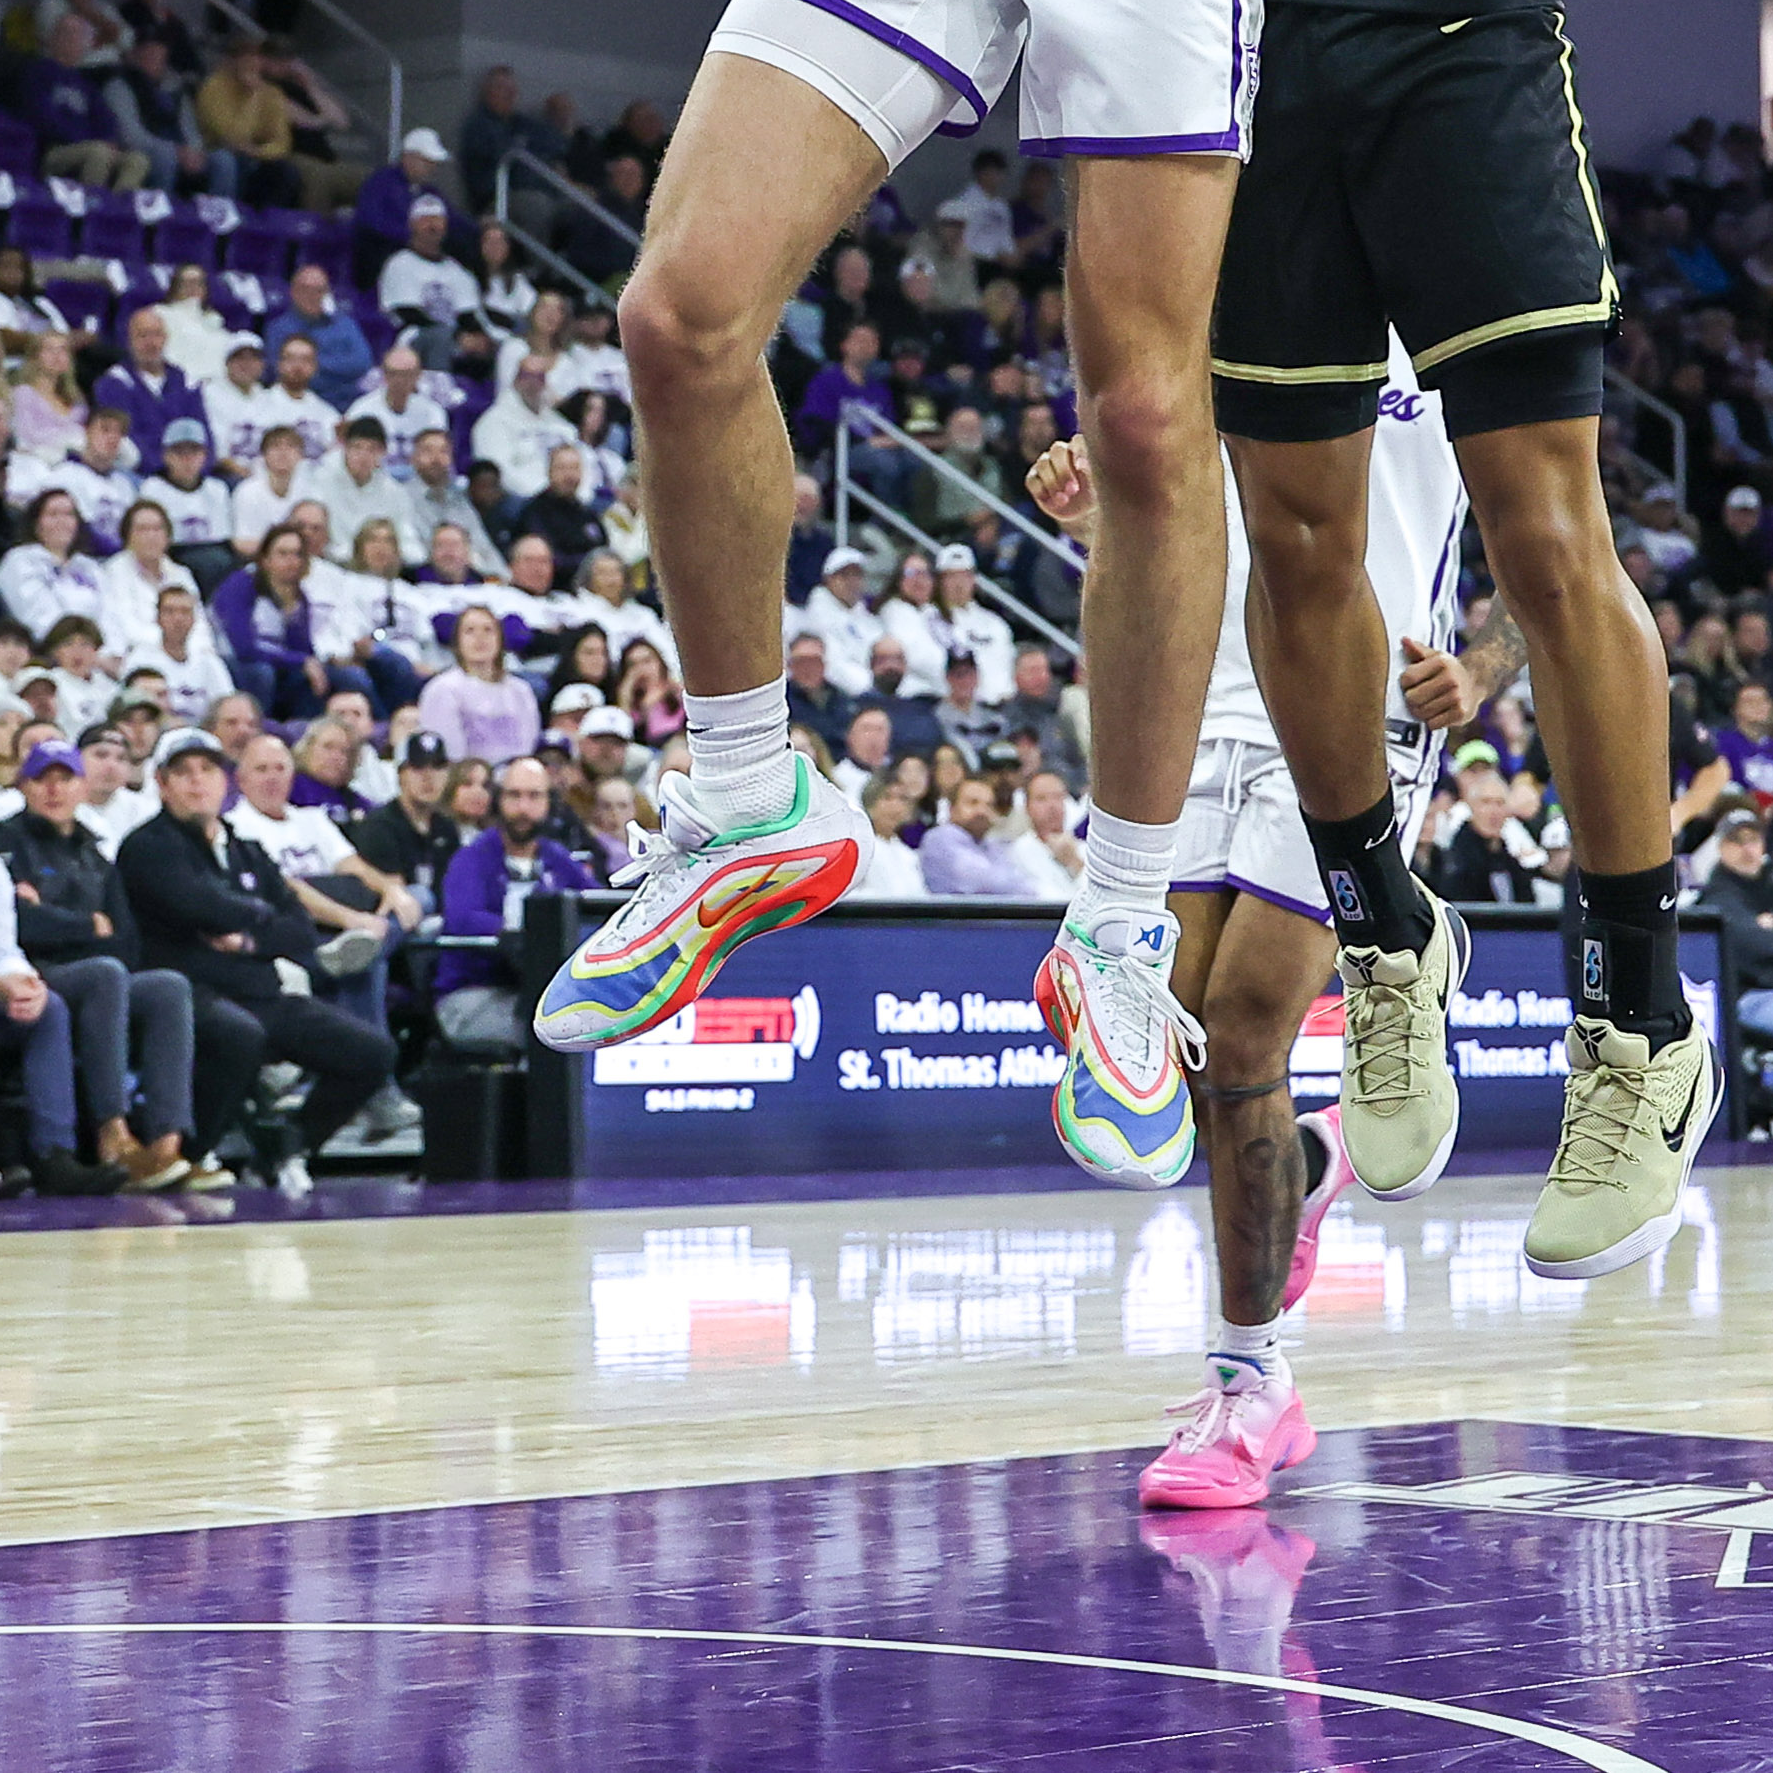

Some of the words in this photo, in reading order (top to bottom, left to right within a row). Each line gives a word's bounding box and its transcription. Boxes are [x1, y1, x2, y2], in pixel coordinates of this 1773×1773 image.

[875, 991, 959, 1035] Radio
[960, 992, 1047, 1034] Home
[1448, 989, 1517, 1027] Radio
[1517, 989, 1574, 1027] Hom
[838, 1049, 881, 1091] St.
[881, 1047, 997, 1090] Thomas
[998, 1047, 1070, 1089] Athle
[1453, 1038, 1549, 1078] Thomas
